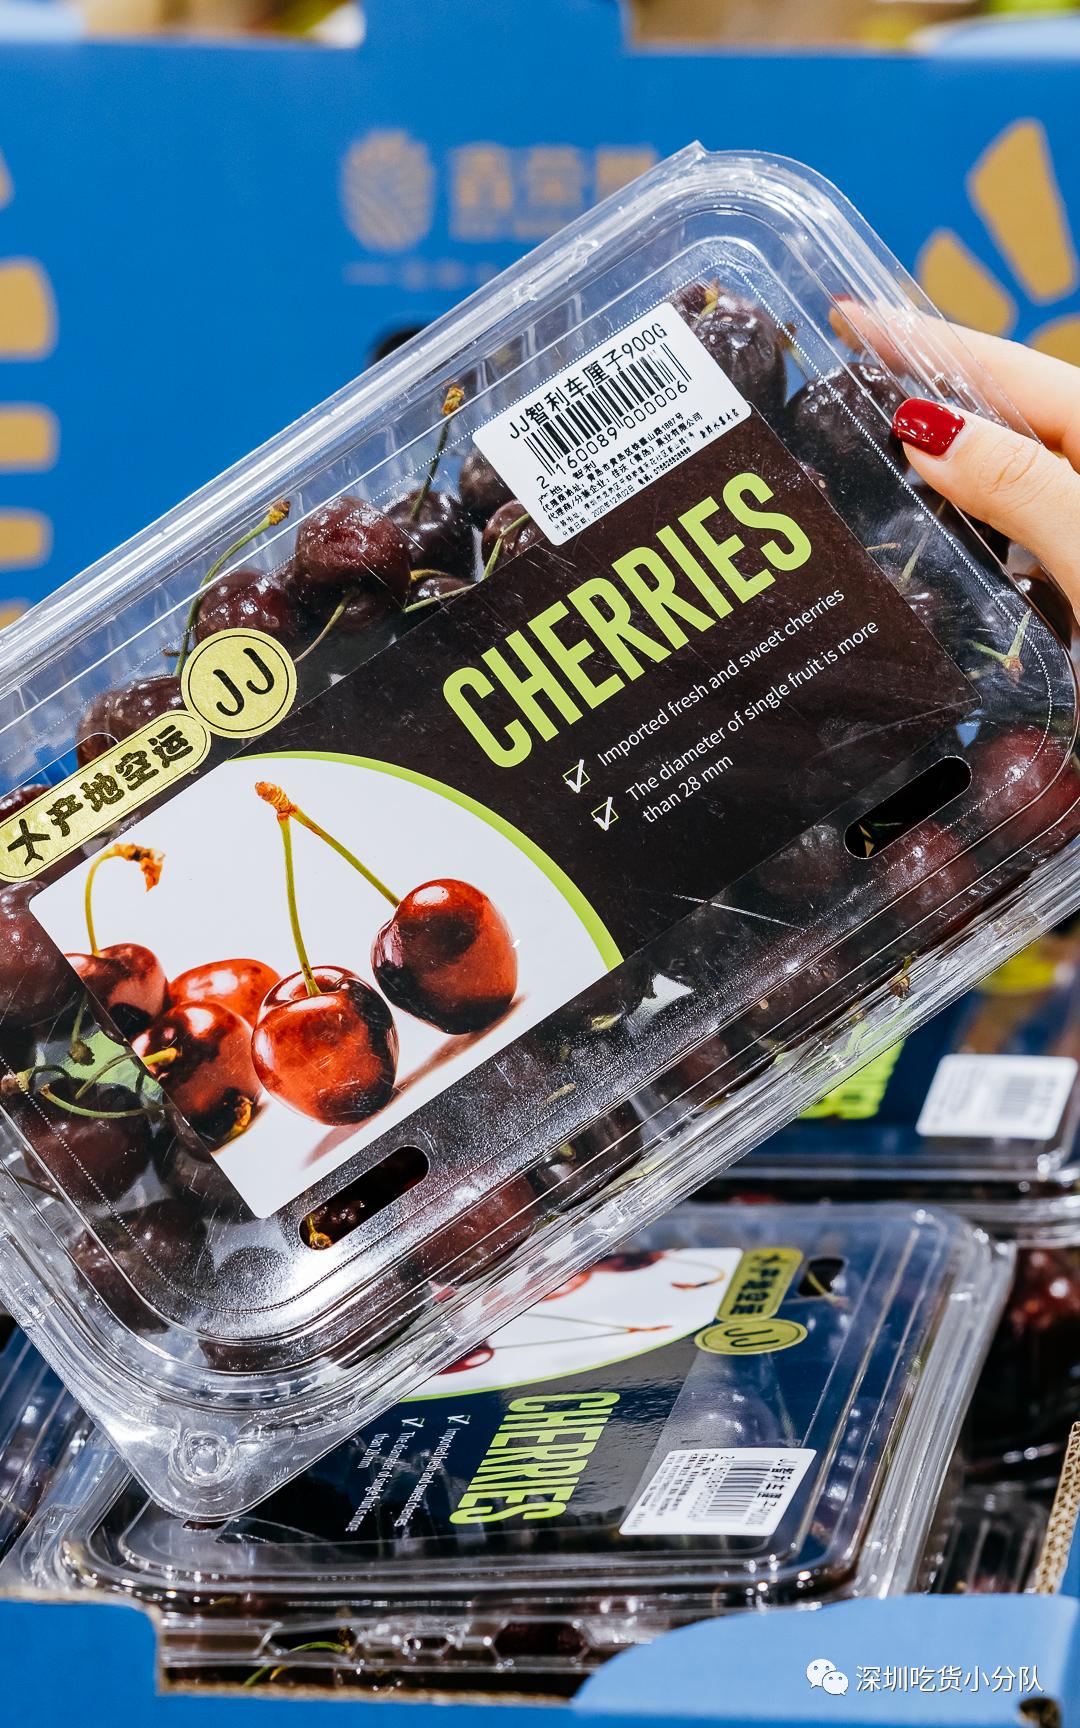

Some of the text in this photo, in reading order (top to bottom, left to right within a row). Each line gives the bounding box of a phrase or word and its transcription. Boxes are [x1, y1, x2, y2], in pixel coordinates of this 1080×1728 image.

[509, 322, 668, 440] JJ智利车厘子900G
[443, 472, 812, 768] CHERRIES
[212, 647, 275, 717] JJ
[597, 588, 845, 767] Imported fresh and sweet cherries
[625, 620, 879, 801] The diameter of single fruit is more
[47, 724, 194, 837] 产地空运
[642, 754, 734, 823] than 28 mm
[724, 1327, 780, 1348] JJ
[368, 1433, 390, 1450] than
[396, 1431, 416, 1446] The
[433, 1428, 461, 1456] Imported
[381, 1444, 408, 1471] diameter
[426, 1456, 448, 1471] fresh
[448, 1391, 620, 1525] CHERRIES
[365, 1478, 389, 1495] single
[418, 1471, 434, 1484] and
[407, 1484, 428, 1501] sweet
